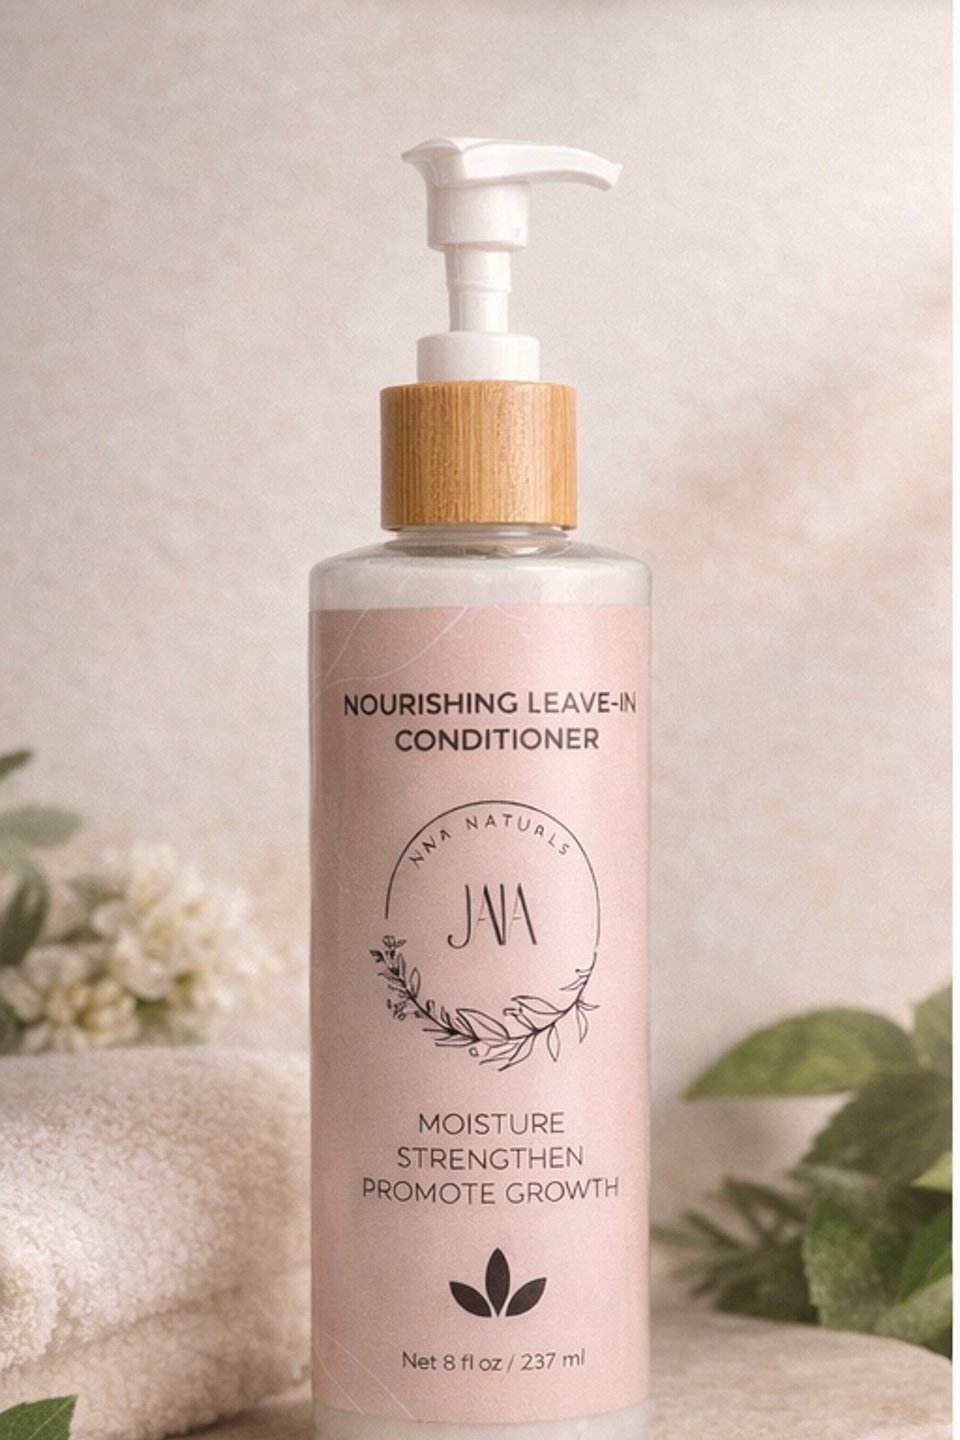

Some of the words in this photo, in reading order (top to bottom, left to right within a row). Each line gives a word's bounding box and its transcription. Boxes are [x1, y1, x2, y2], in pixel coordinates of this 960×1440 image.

[345, 691, 518, 715] NOURISHING
[528, 691, 636, 713] LEAVE-IN
[395, 728, 599, 752] CONDITIONER
[419, 1112, 564, 1135] MOISTURE
[397, 1146, 583, 1170] STRENGTHEN
[363, 1177, 496, 1204] PROMOTE
[506, 1177, 618, 1204] GROWTH
[402, 1351, 437, 1370] Net
[443, 1354, 456, 1371] 8
[461, 1354, 473, 1370] fl
[478, 1358, 502, 1372] oz
[506, 1354, 515, 1373] /
[521, 1352, 556, 1371] 237
[562, 1348, 585, 1366] ml
